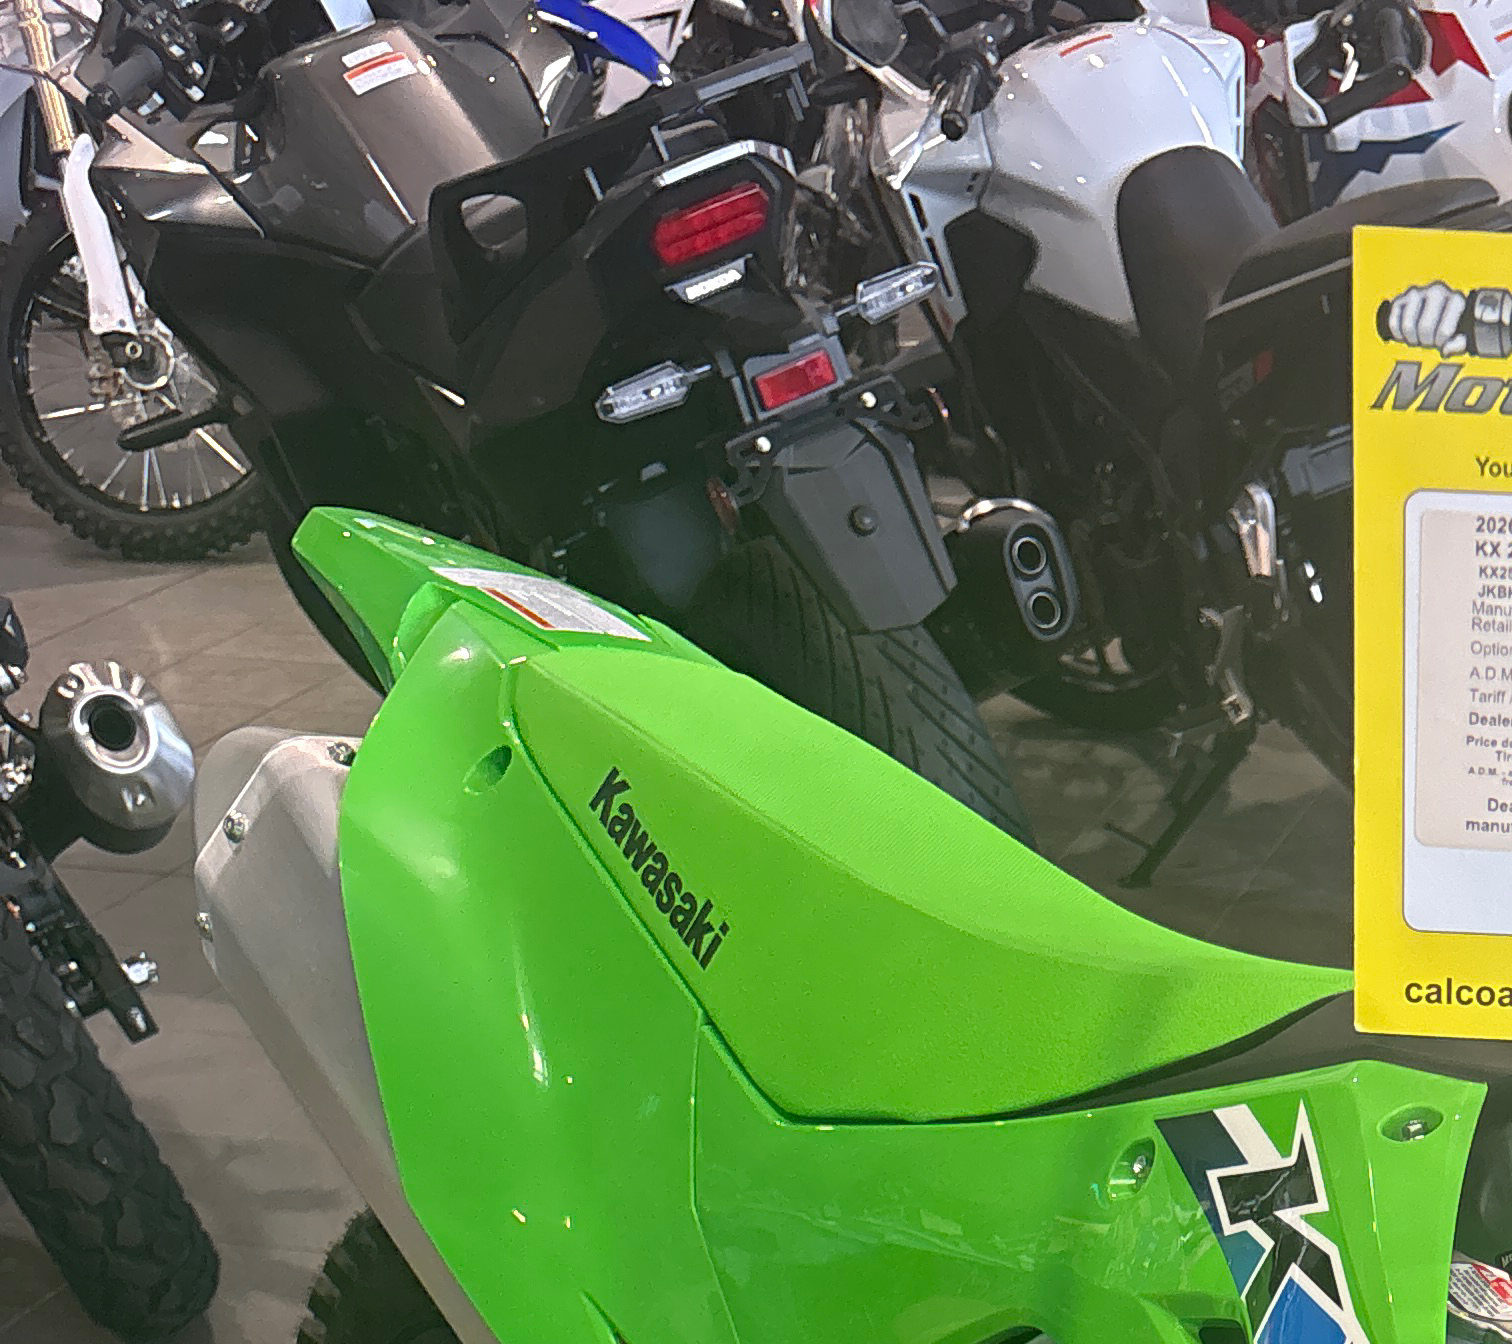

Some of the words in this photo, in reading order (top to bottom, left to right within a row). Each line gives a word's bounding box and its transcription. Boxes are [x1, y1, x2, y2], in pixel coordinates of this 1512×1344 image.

[1475, 541, 1501, 558] KX
[1471, 617, 1512, 634] Retail
[1470, 688, 1505, 703] Tariff
[1466, 735, 1498, 748] Price
[588, 766, 730, 970] Kawasaki
